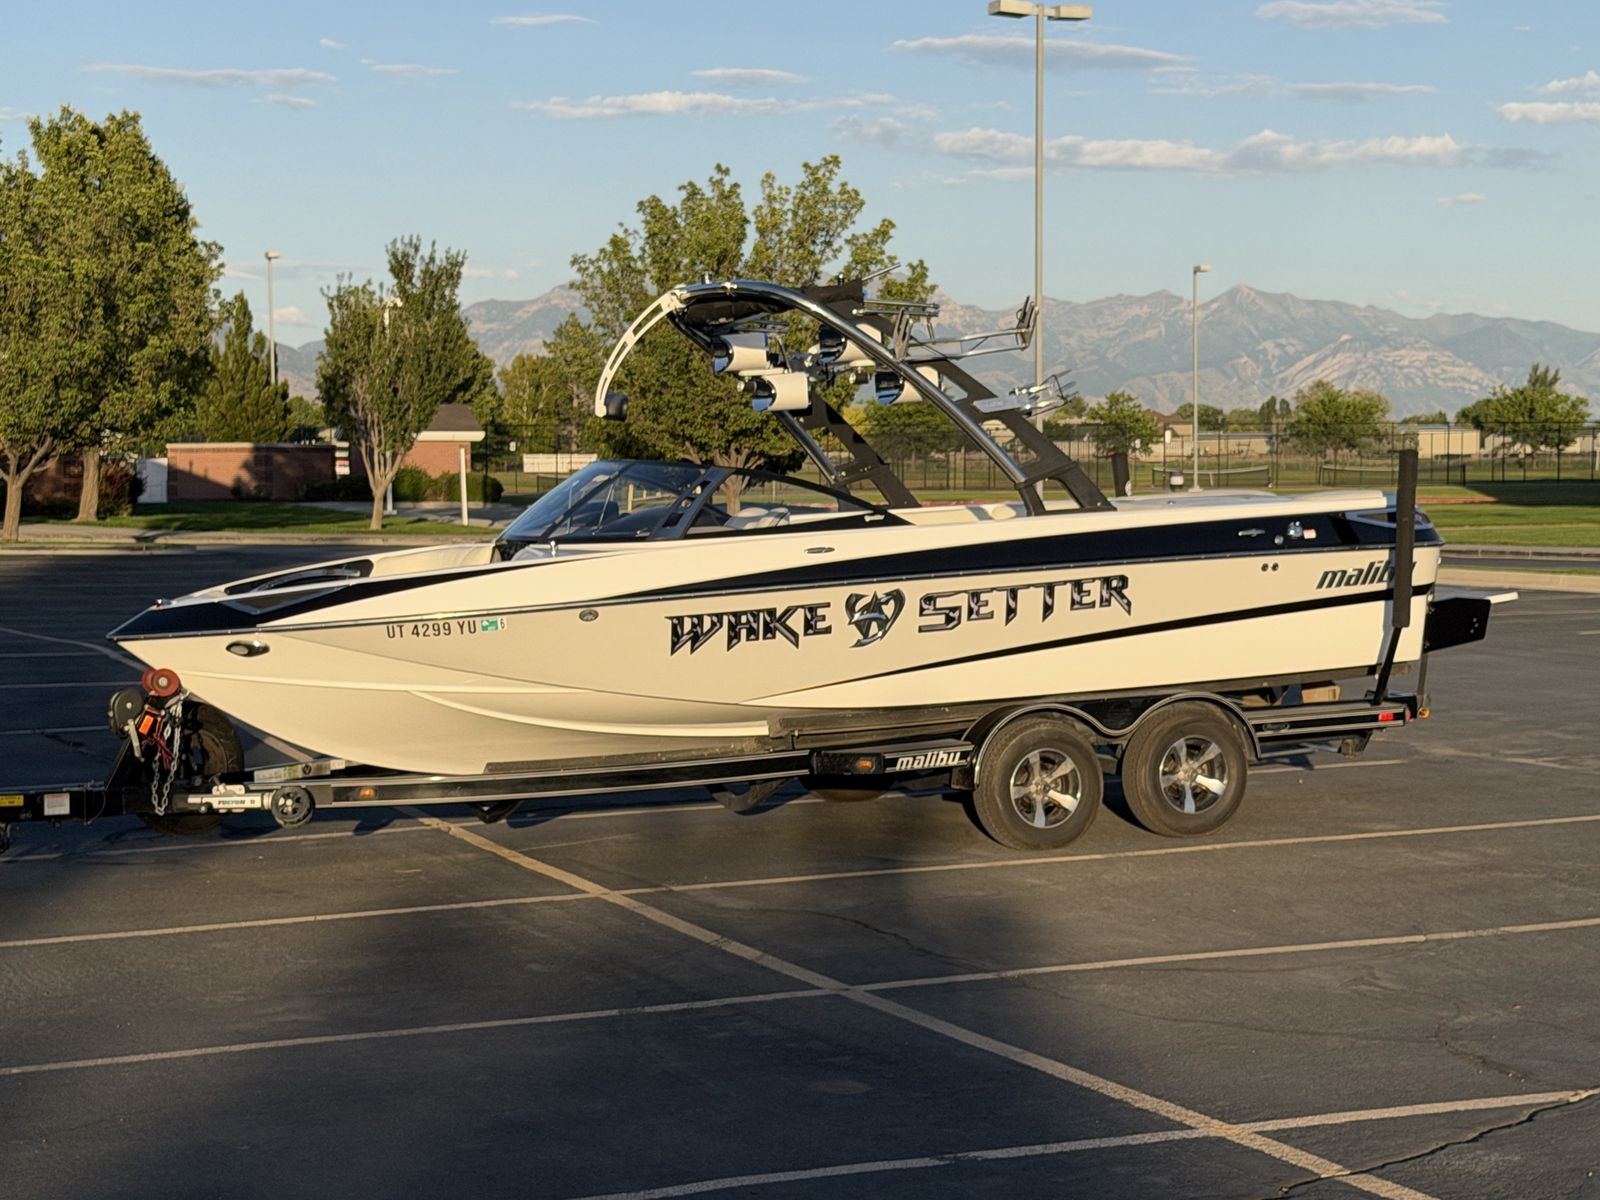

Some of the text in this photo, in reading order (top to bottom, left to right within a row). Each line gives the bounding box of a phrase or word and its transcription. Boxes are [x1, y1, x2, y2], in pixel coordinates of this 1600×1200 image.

[1316, 560, 1417, 590] malib
[664, 574, 1132, 656] WAKE SETTER
[386, 624, 405, 638] UT
[411, 621, 452, 638] 4299
[457, 620, 477, 635] YU
[896, 751, 961, 771] malibu
